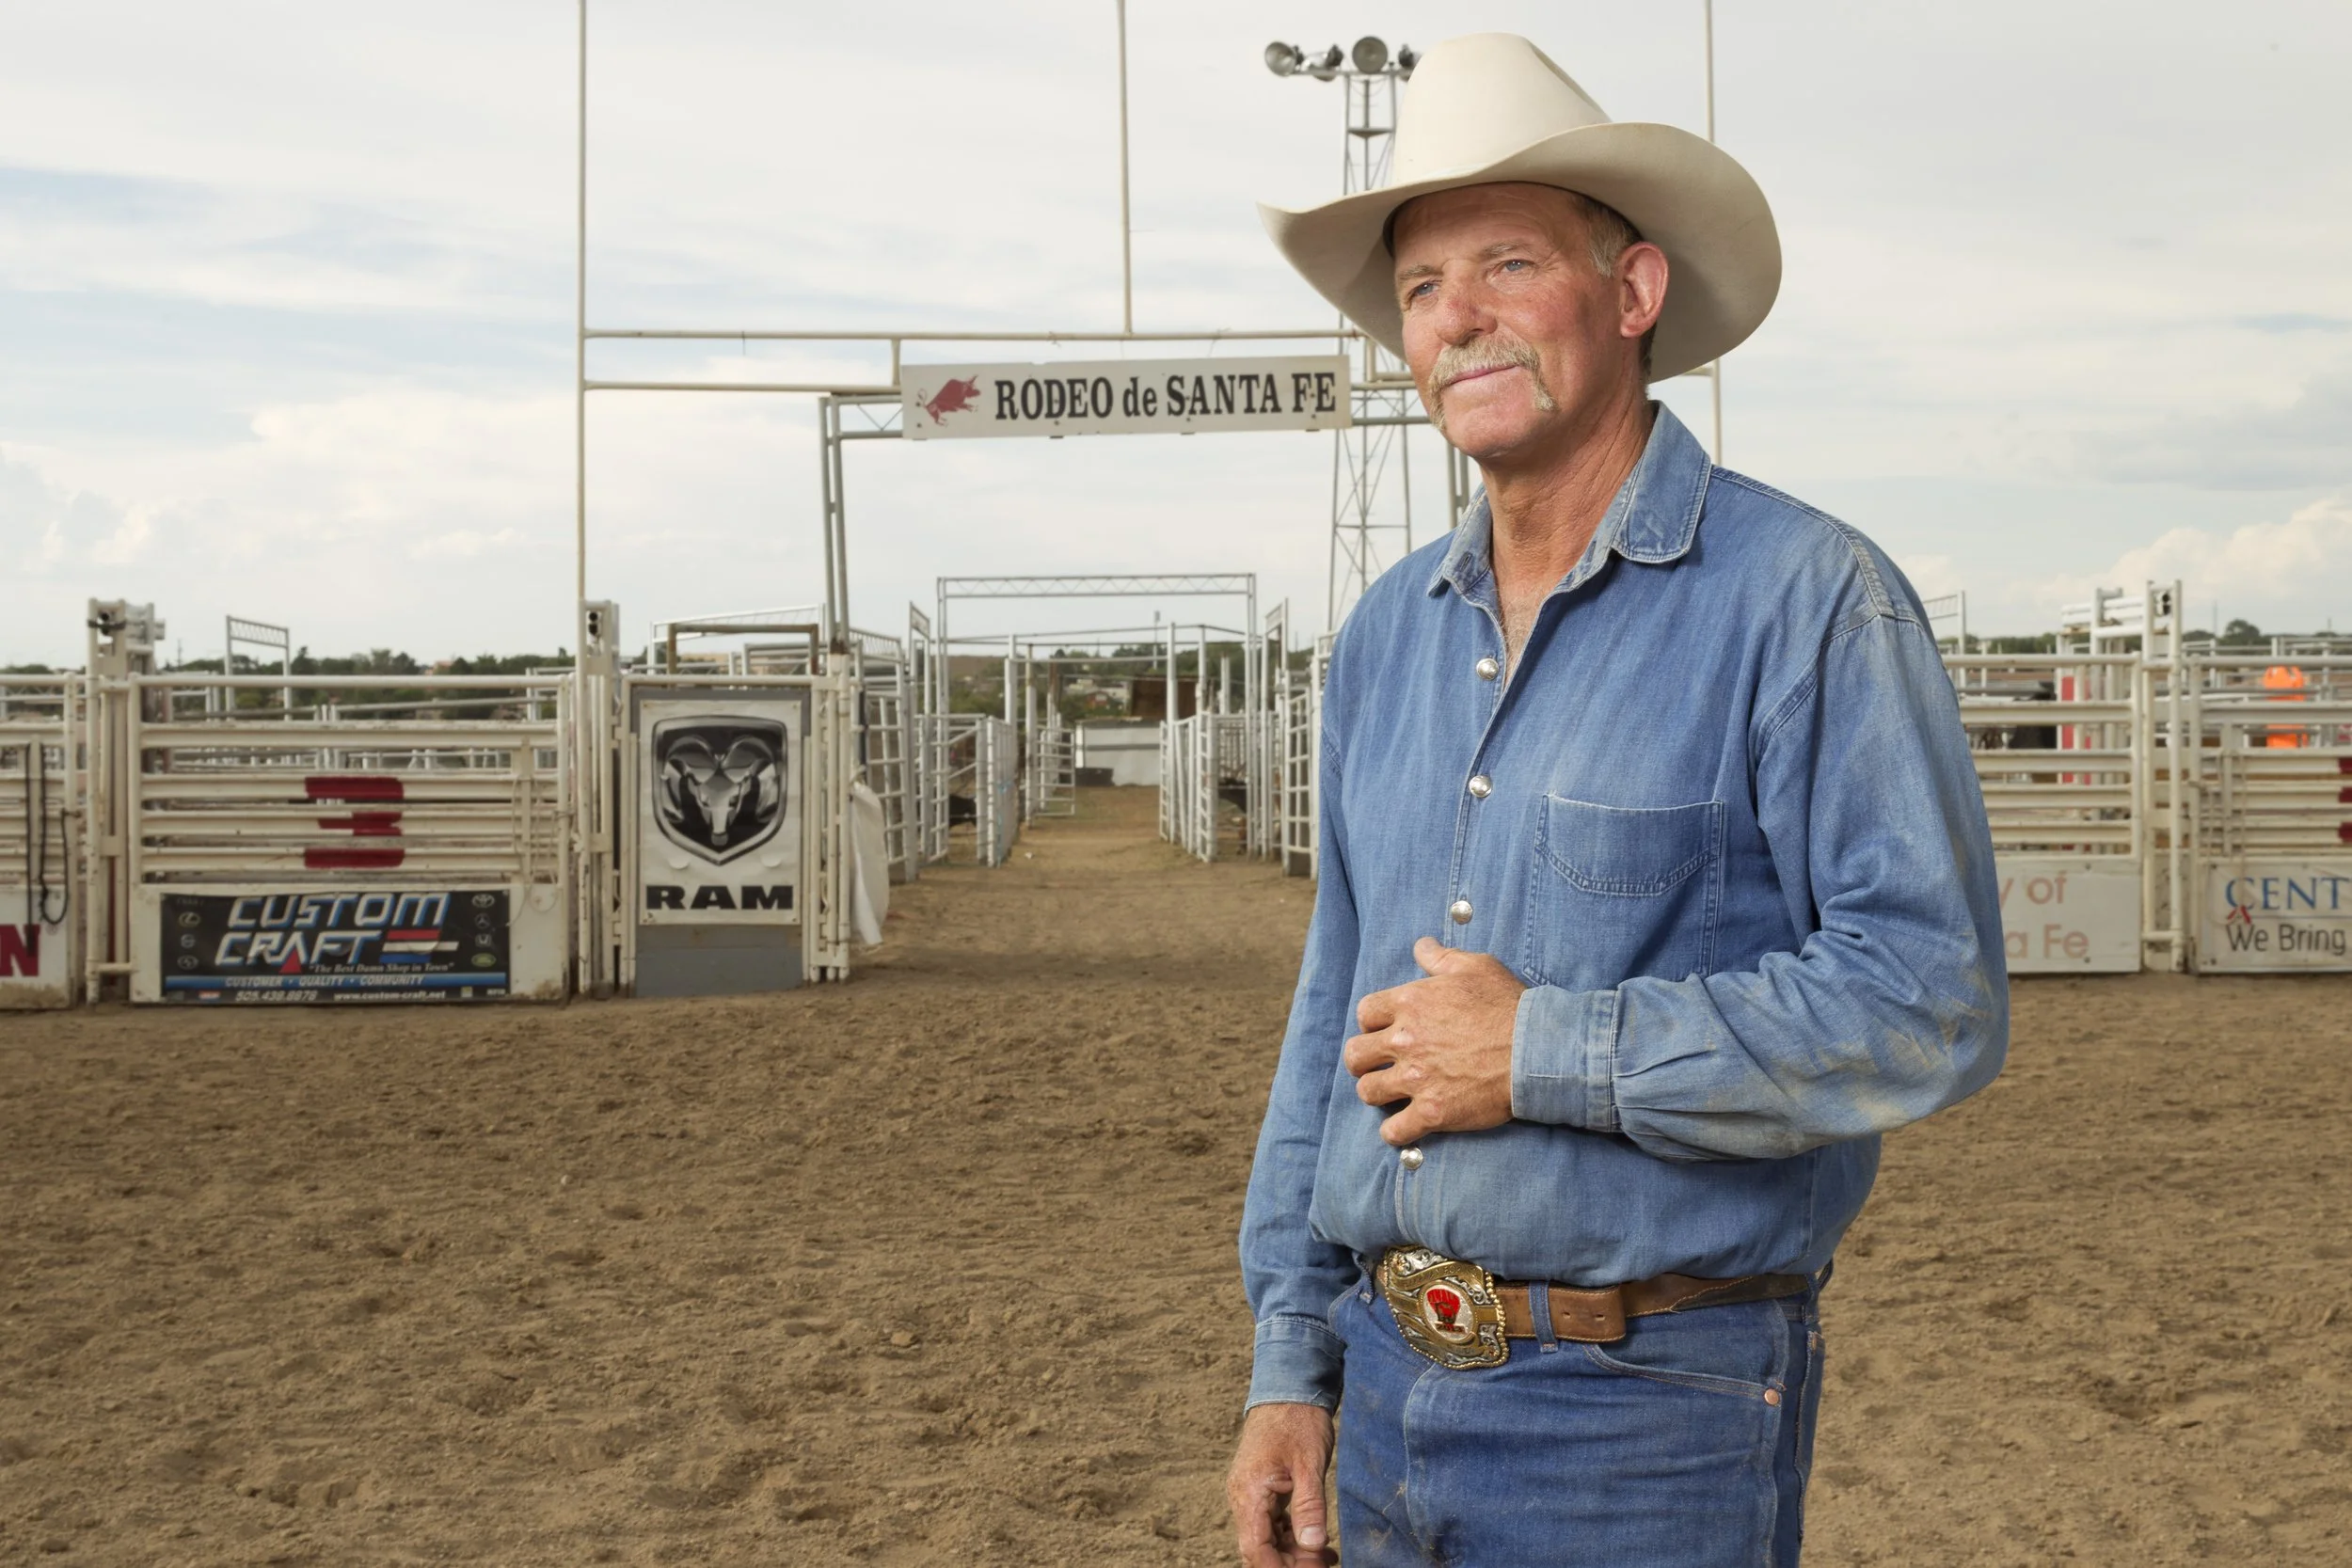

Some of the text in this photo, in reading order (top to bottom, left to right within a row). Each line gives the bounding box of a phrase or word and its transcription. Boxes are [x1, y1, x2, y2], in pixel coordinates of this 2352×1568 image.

[994, 372, 1336, 420] RODEO de SANTA FE
[646, 884, 794, 911] RAM
[2026, 869, 2068, 905] of
[2224, 876, 2350, 911] CENT
[228, 892, 451, 928] CUSTOM
[214, 930, 382, 967] CRAFT
[2043, 924, 2090, 959] Fe
[2225, 923, 2346, 957] We Bring
[225, 974, 425, 987] CUSTOMER QUALITY COMMUNITY
